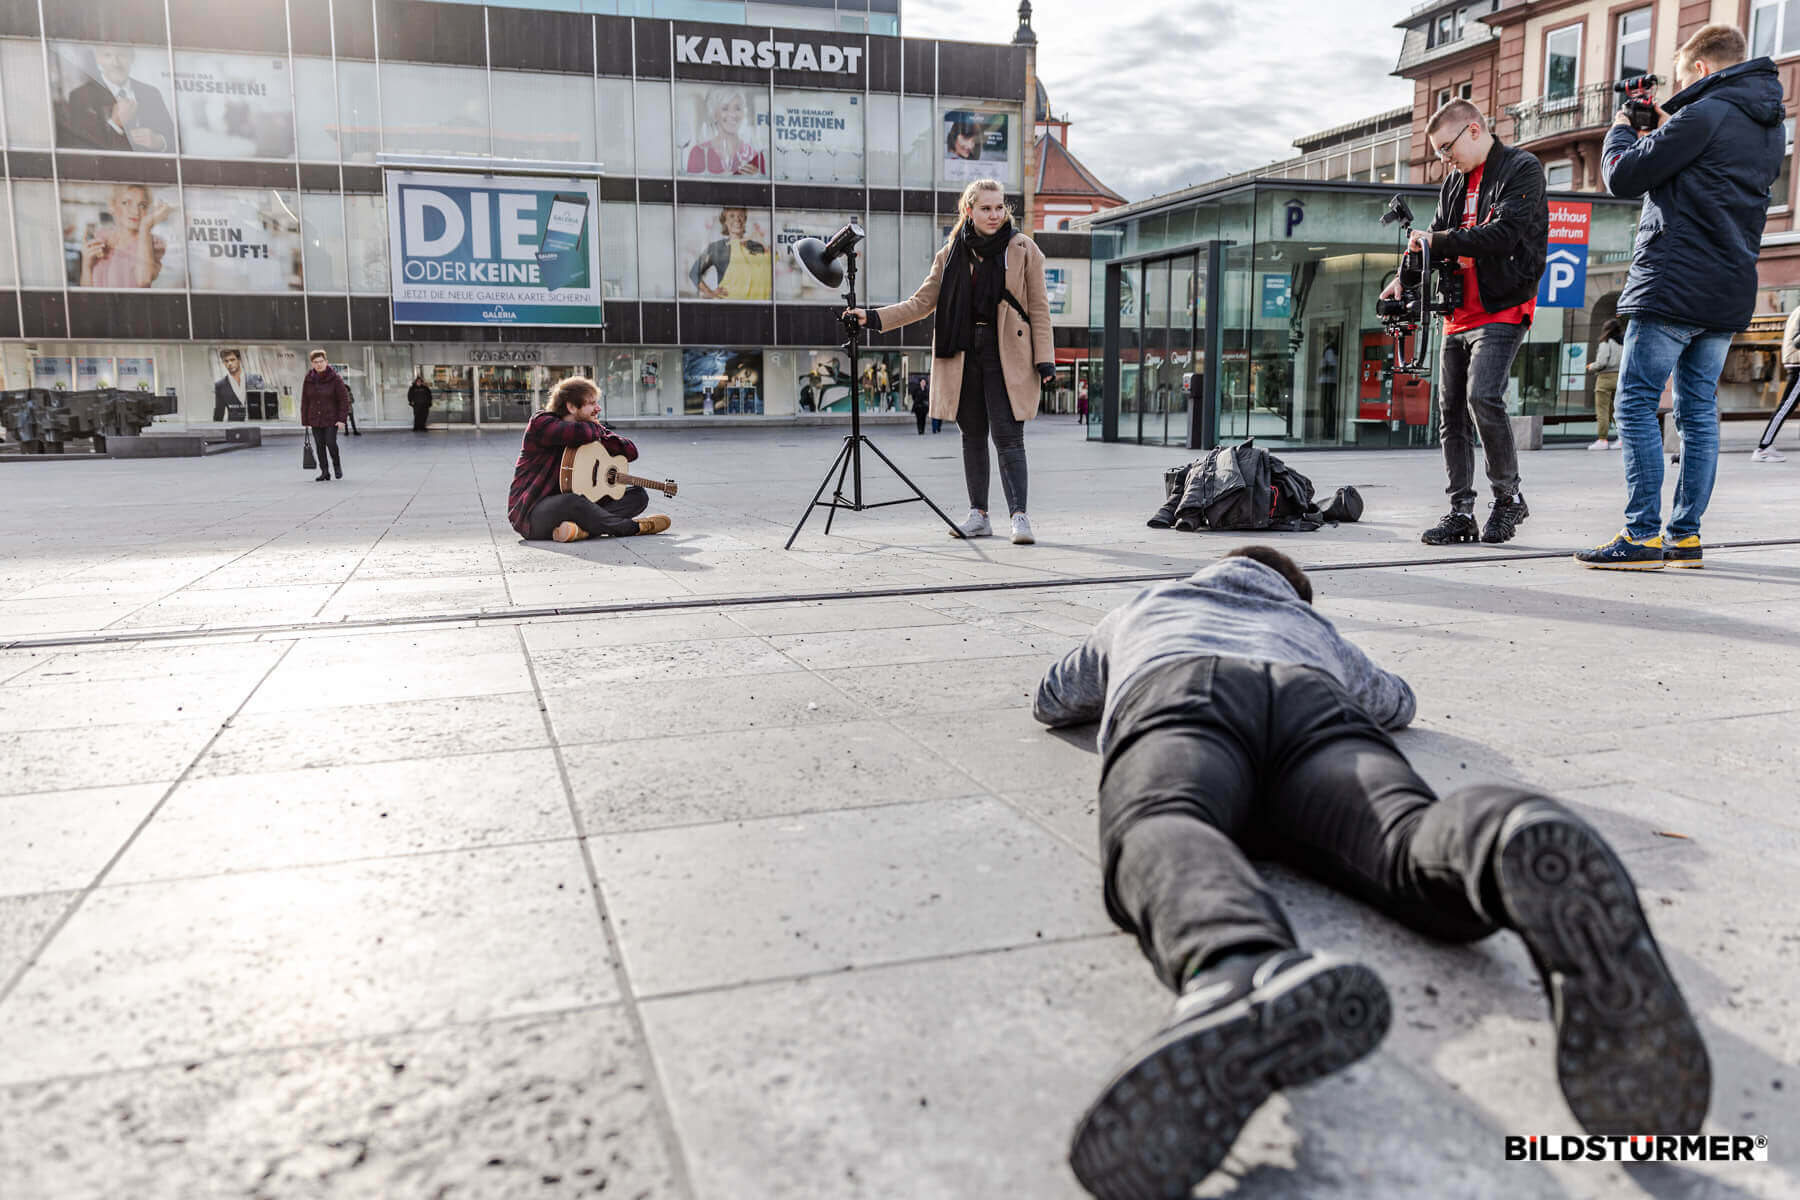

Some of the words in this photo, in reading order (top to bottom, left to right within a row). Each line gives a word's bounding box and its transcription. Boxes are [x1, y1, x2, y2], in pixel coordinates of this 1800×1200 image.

[676, 35, 862, 74] KARSTADT
[175, 80, 266, 96] AUSSEHEN!
[788, 115, 845, 130] MEINEN
[776, 128, 822, 141] TISCH!
[1549, 208, 1587, 223] arkhaus
[403, 188, 539, 260] DIE
[188, 227, 242, 242] MEIN
[1549, 226, 1583, 238] entrum
[209, 244, 269, 259] DUFT!
[405, 260, 468, 281] ODER
[469, 262, 541, 283] KEINE
[1548, 263, 1575, 302] P
[404, 289, 427, 298] JETZT
[430, 290, 444, 299] DIE
[448, 291, 472, 300] NEUE
[476, 292, 514, 300] GALERIA
[518, 293, 545, 301] KARTE
[550, 294, 591, 303] SICHERN!
[482, 311, 517, 319] GALERIA
[470, 351, 541, 361] KARSTADT
